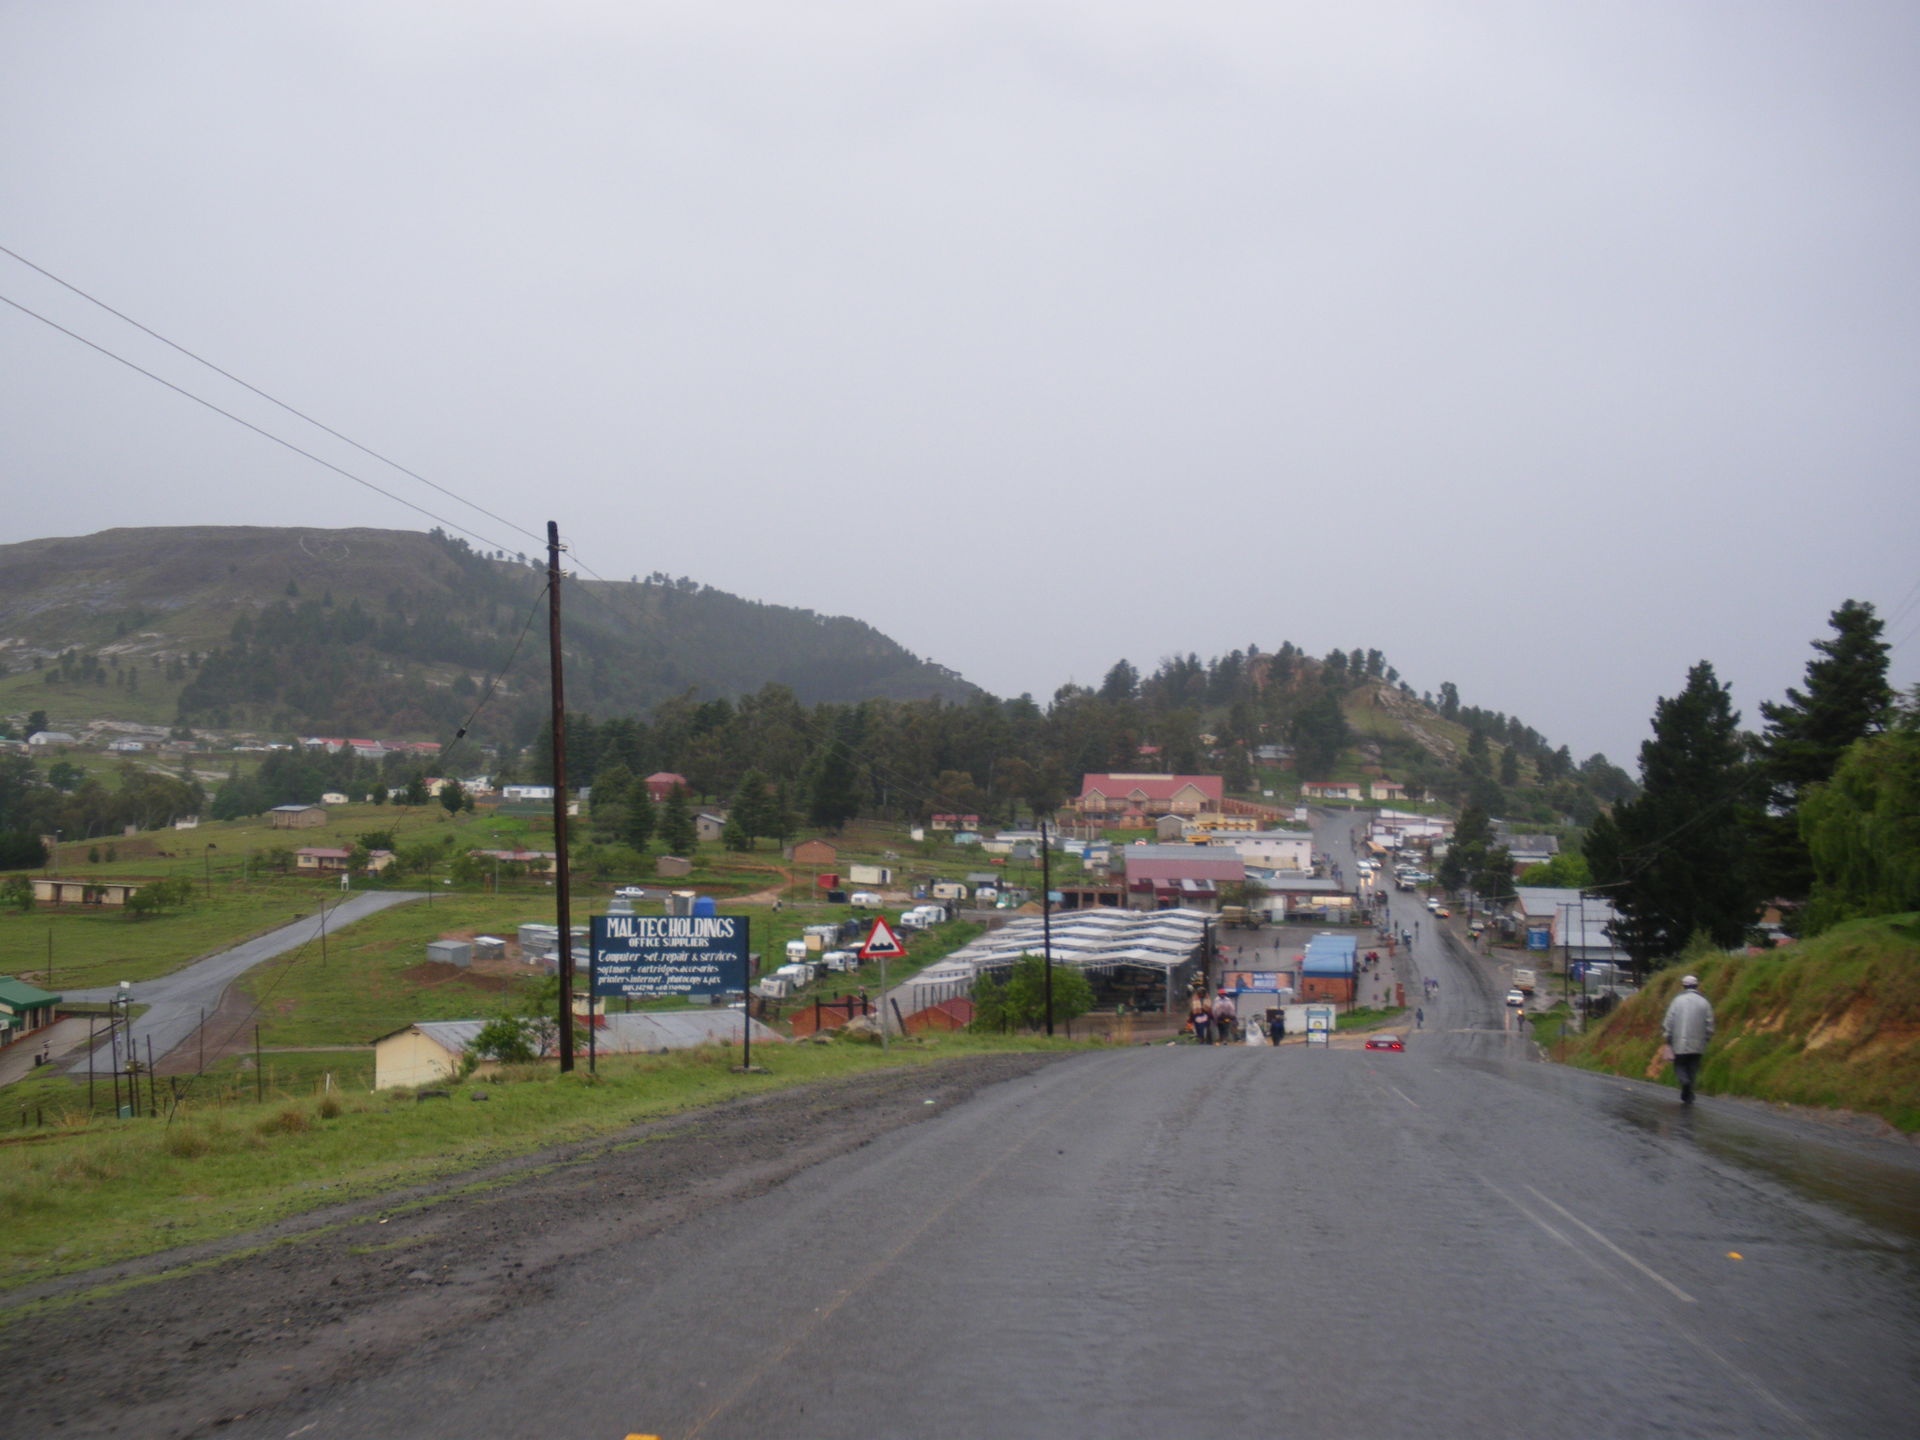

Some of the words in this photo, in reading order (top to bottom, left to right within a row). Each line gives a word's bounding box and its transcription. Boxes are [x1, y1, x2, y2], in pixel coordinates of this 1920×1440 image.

[628, 938, 660, 948] OFFICE
[663, 938, 710, 948] SUPPLIERS
[597, 950, 641, 963] Computer
[699, 950, 738, 962] services
